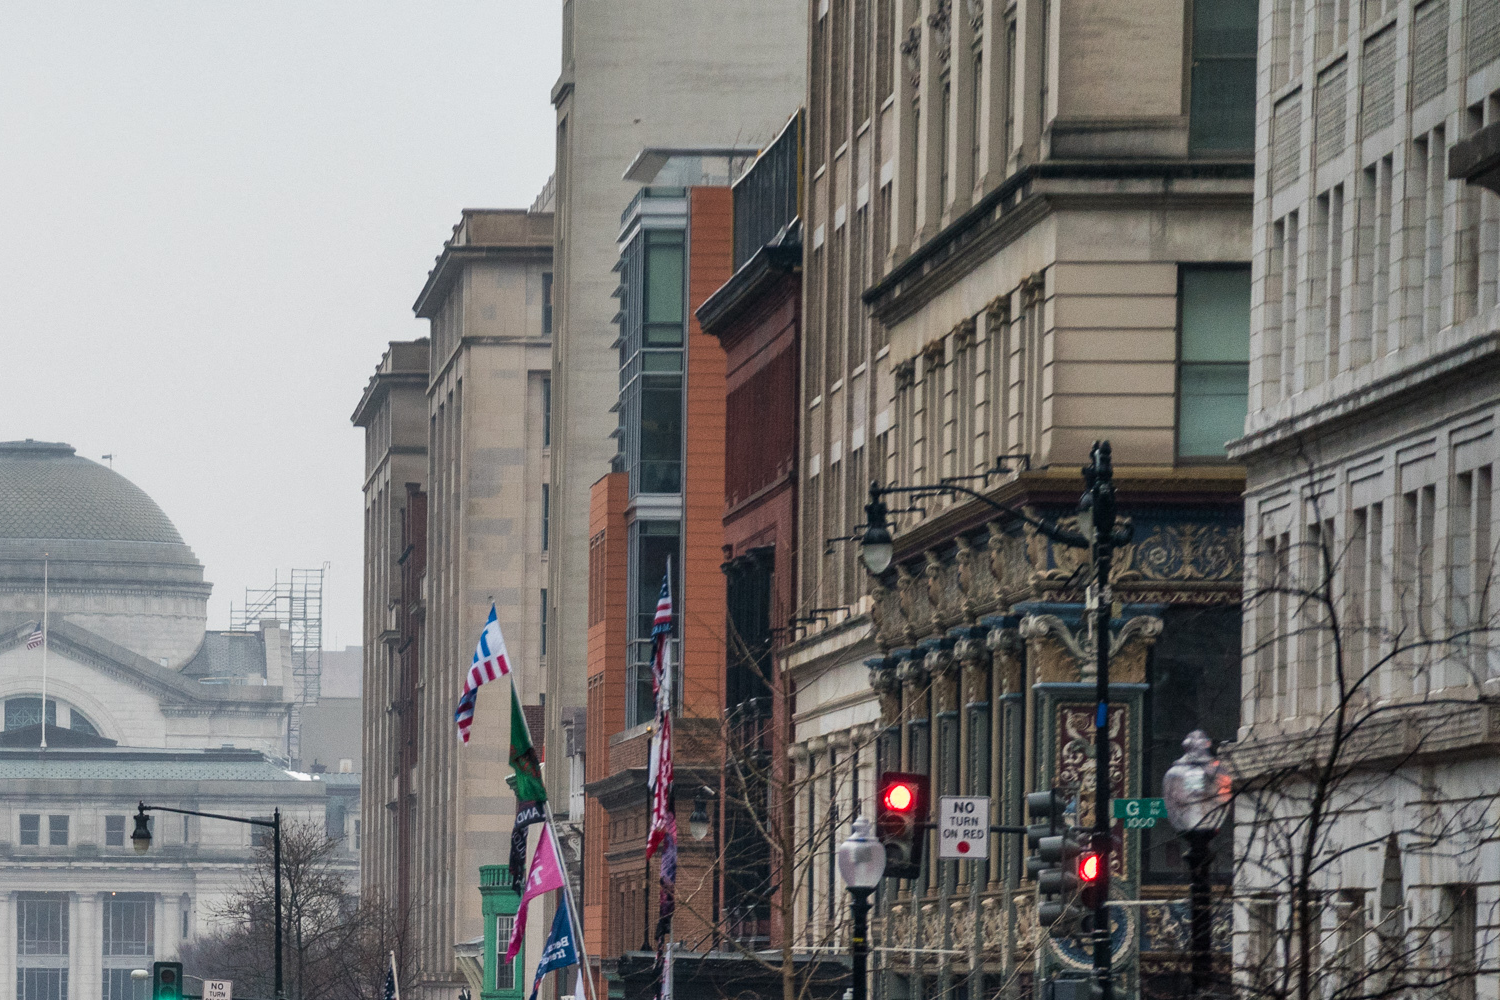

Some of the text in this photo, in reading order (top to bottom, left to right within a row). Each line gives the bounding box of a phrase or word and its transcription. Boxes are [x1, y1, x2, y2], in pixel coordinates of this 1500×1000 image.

[953, 801, 975, 814] NO
[1126, 801, 1140, 816] G
[950, 816, 979, 826] TURN
[943, 829, 984, 839] ON RED
[211, 982, 224, 990] NO
